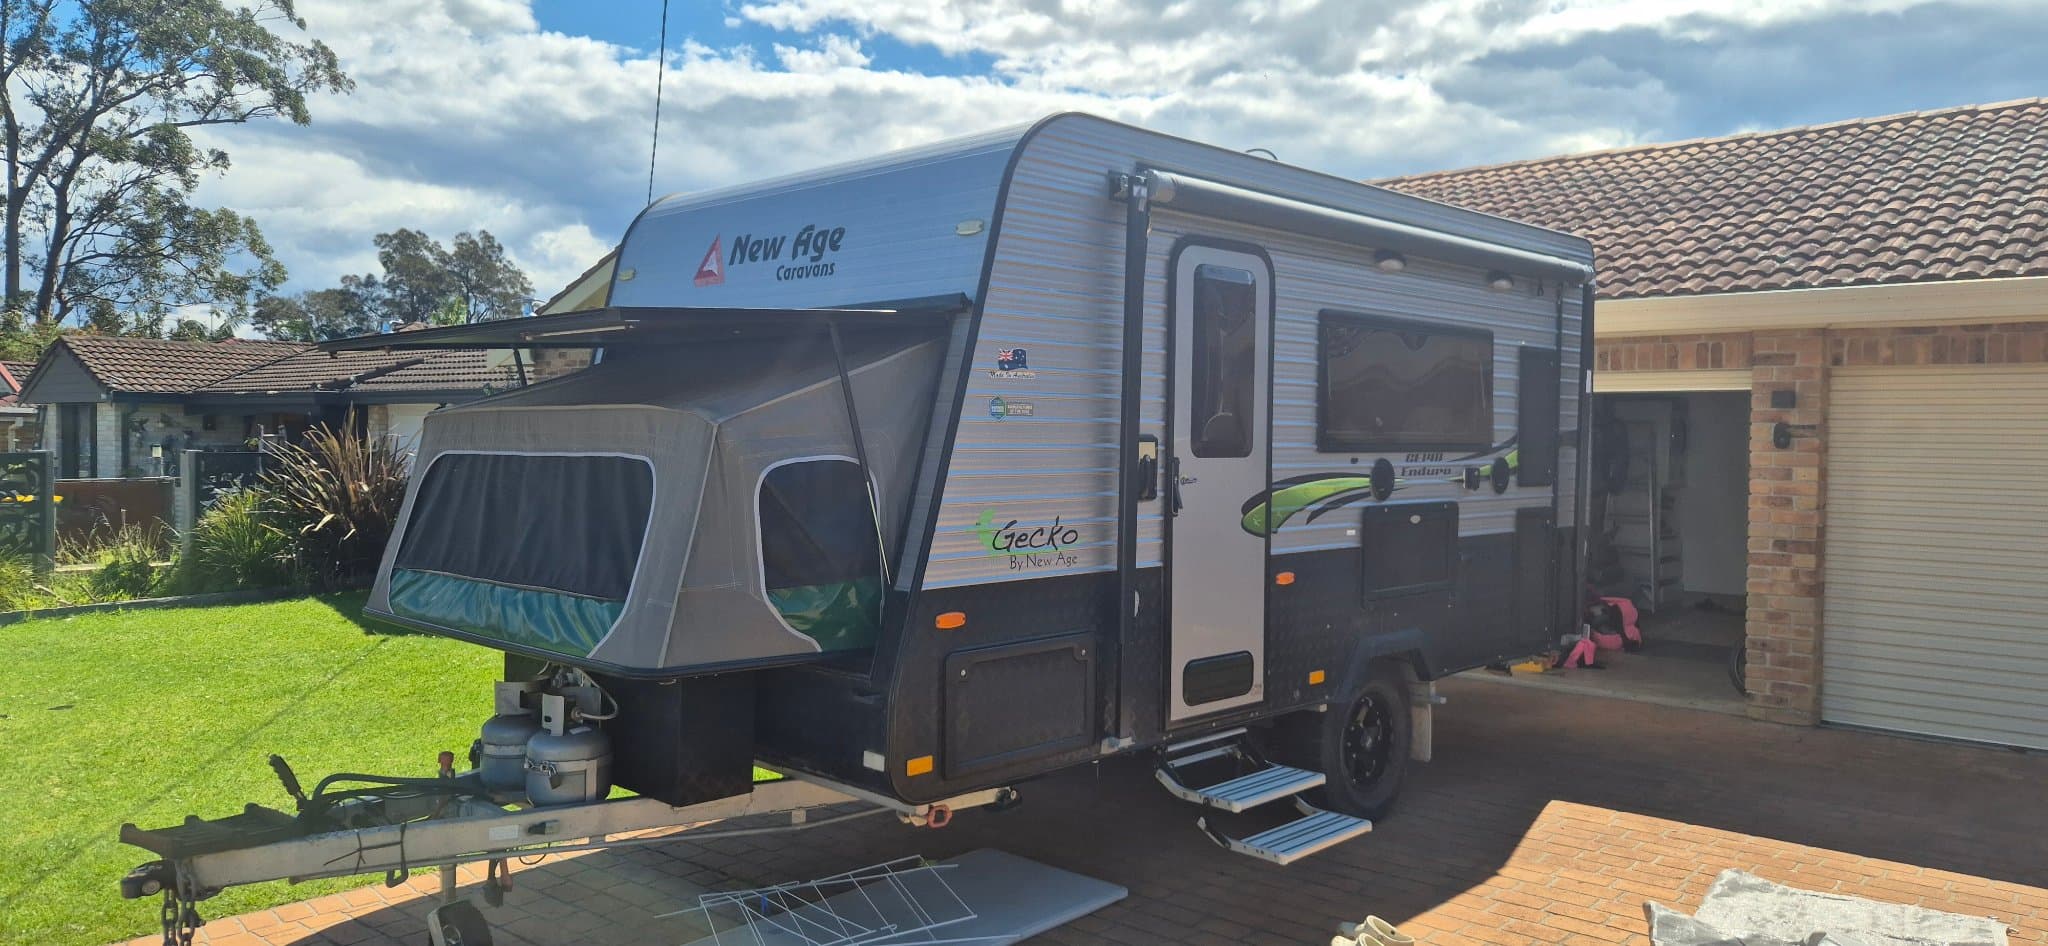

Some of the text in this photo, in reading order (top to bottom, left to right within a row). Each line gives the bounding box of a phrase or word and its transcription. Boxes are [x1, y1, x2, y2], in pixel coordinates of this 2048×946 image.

[728, 224, 846, 266] New Age
[776, 263, 836, 281] Caravans
[1401, 466, 1452, 477] Enduro
[992, 515, 1079, 552] Gecko
[1009, 551, 1078, 571] By New Age
